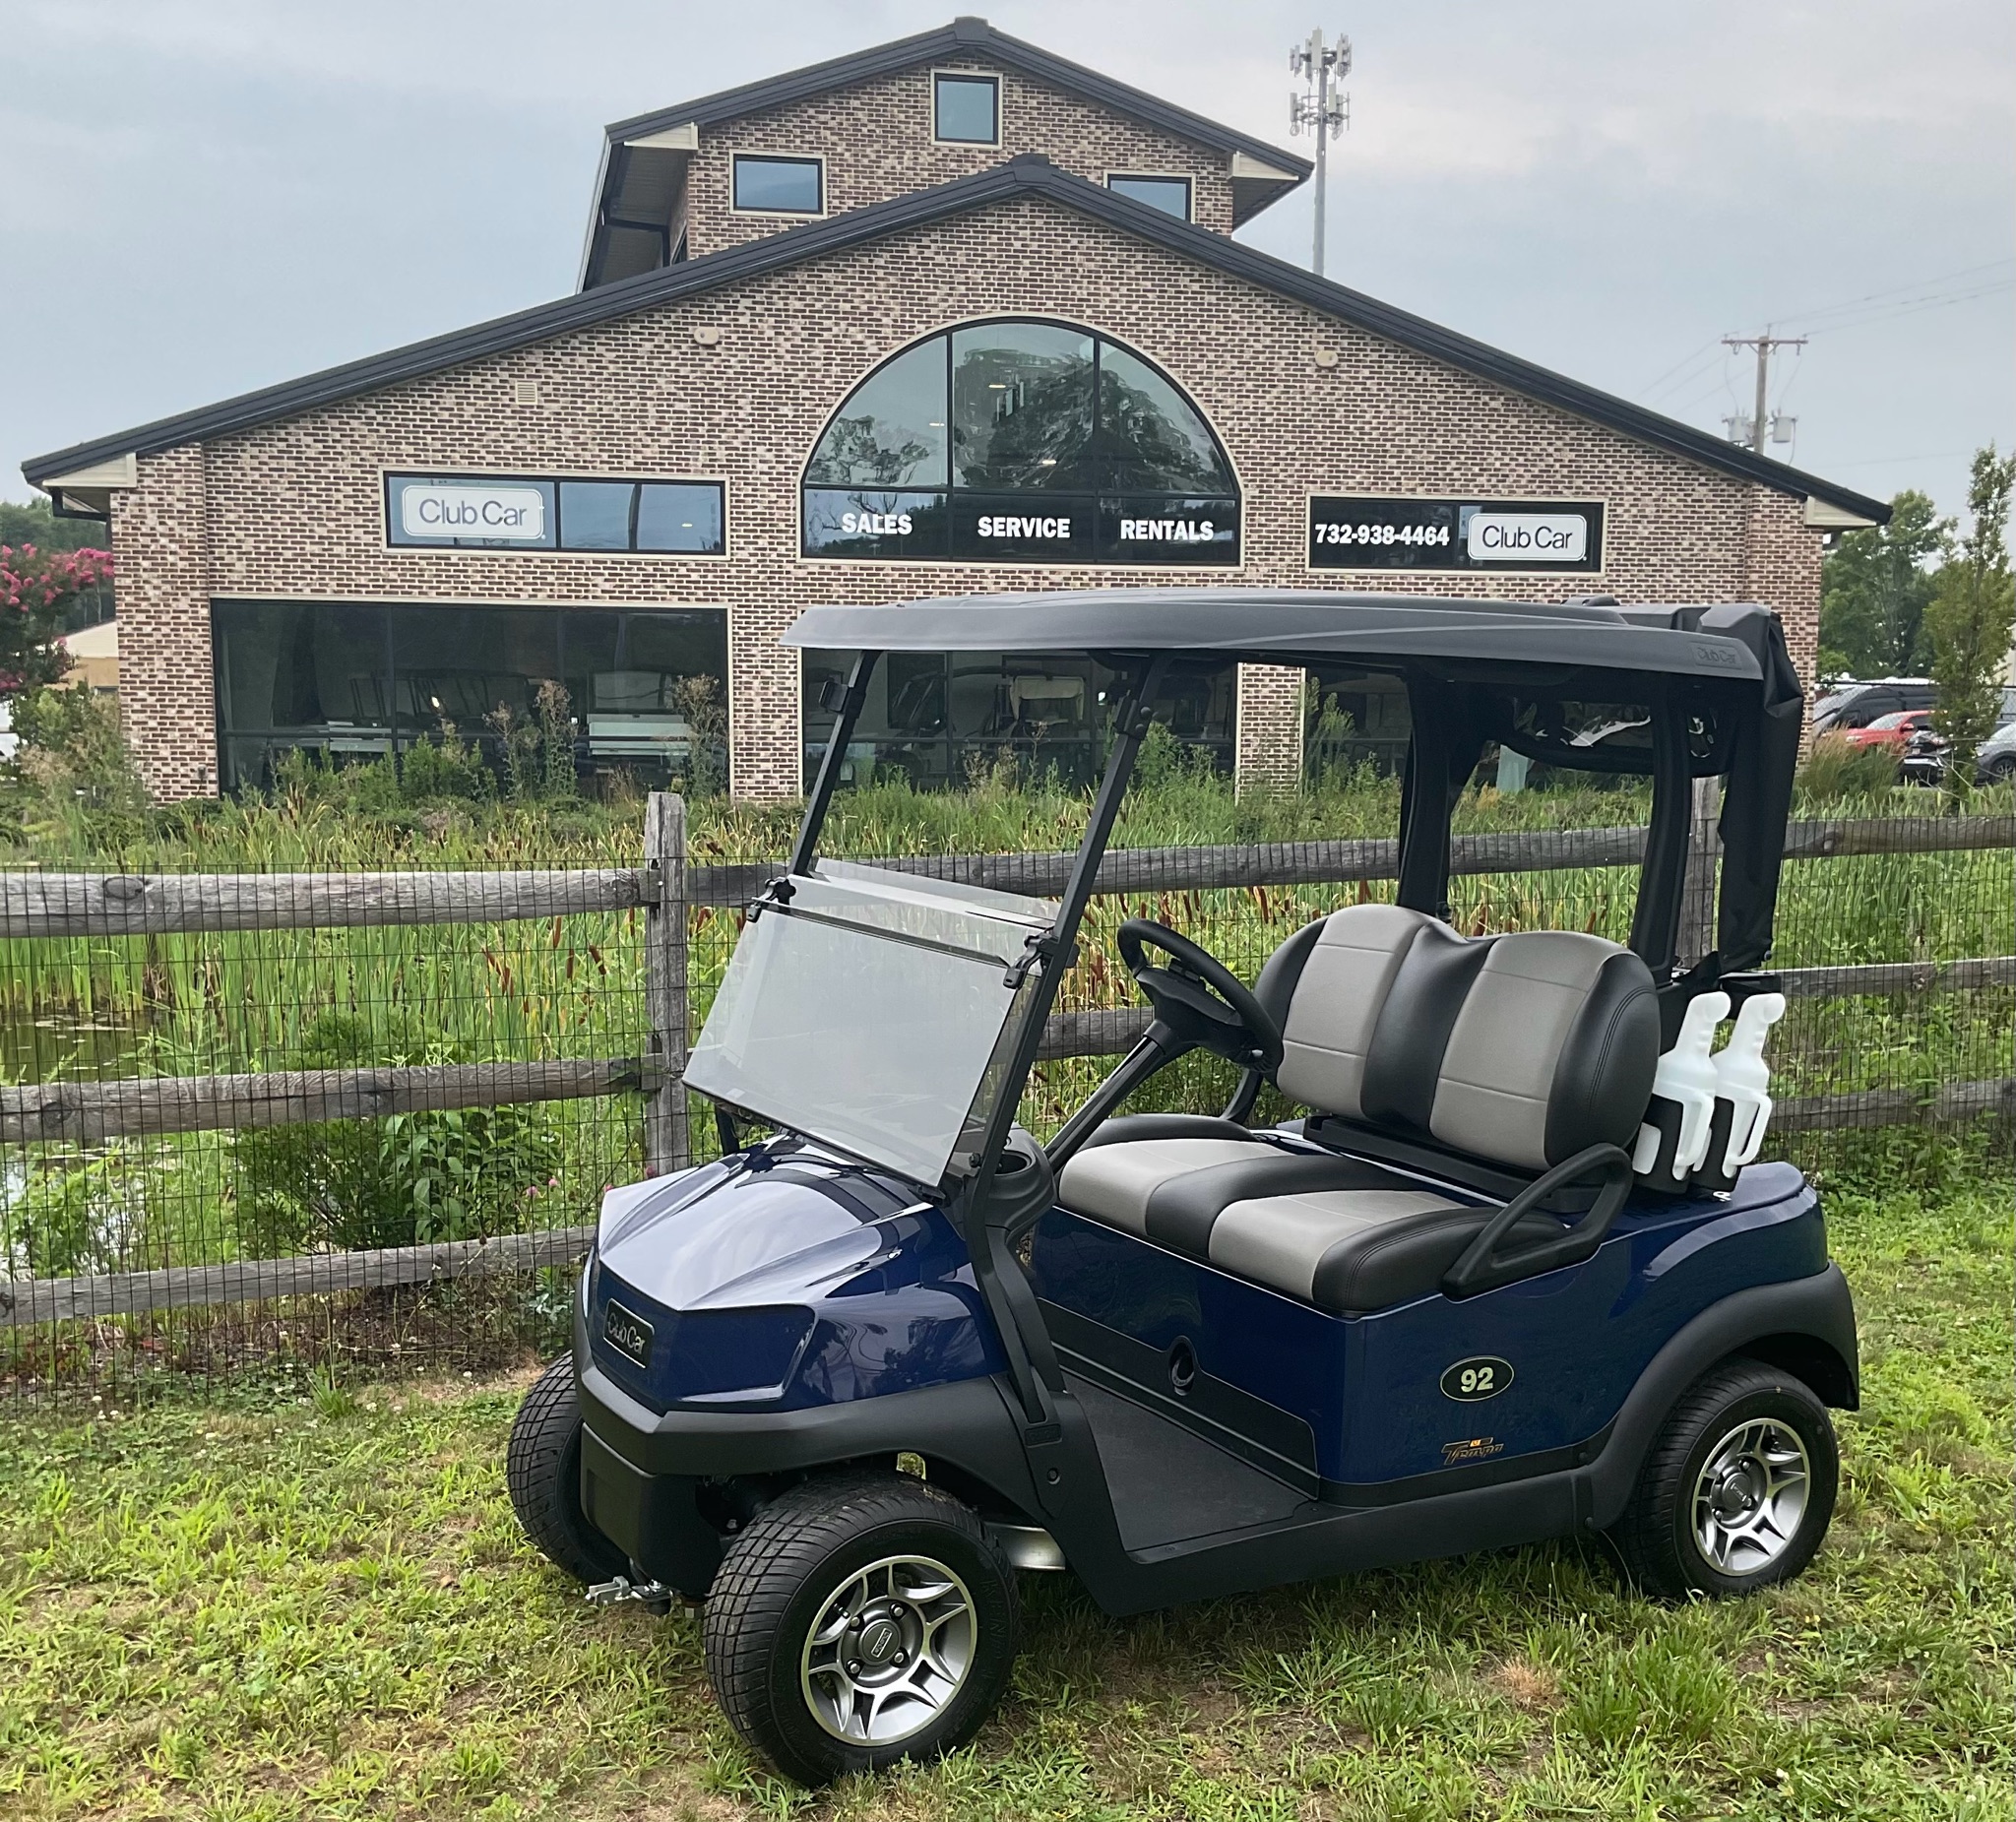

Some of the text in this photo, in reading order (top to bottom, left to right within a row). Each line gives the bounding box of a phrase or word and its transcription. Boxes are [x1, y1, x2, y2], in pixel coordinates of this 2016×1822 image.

[418, 498, 528, 527] Club Car
[842, 512, 1215, 541] SALES SERVICE RENTALS
[1314, 524, 1450, 546] 732-938-4464
[1481, 525, 1573, 549] Club Car
[627, 1325, 646, 1354] Car
[1460, 1366, 1494, 1393] 92
